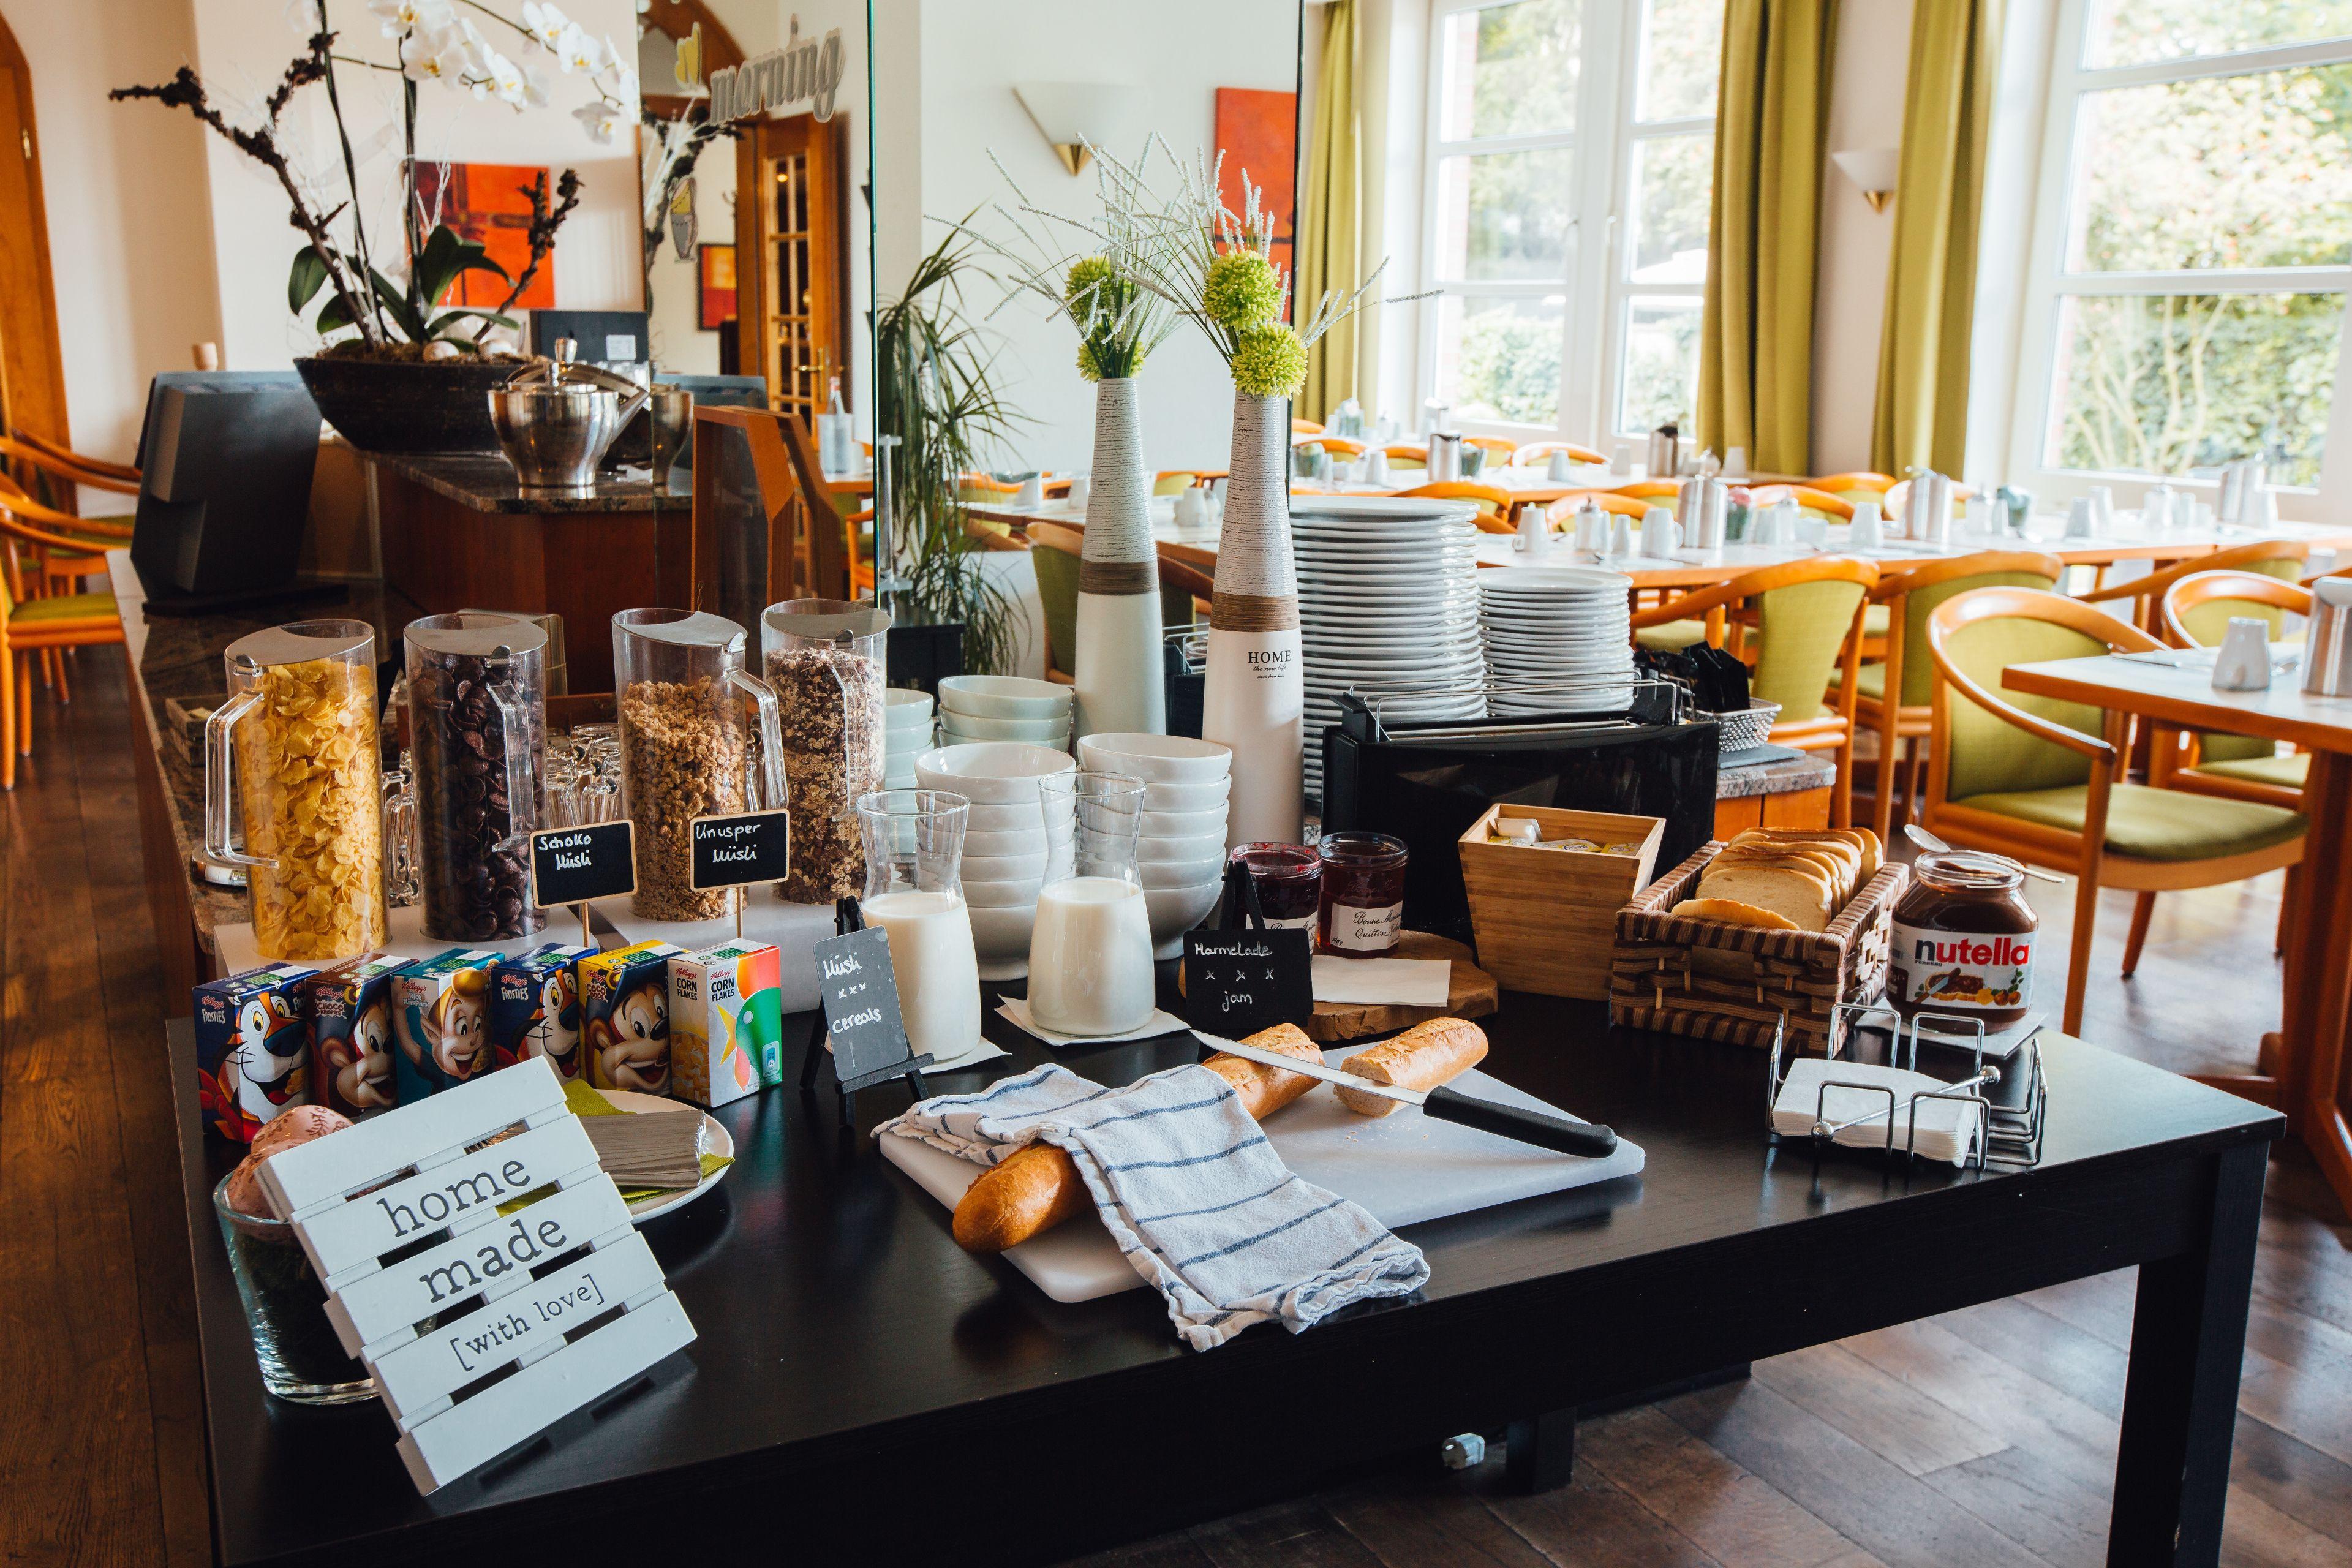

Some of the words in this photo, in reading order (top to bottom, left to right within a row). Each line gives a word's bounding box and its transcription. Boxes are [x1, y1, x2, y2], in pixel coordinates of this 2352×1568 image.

[709, 13, 846, 123] morning
[1248, 650, 1292, 663] HOME
[1277, 663, 1287, 673] life
[1353, 911, 1381, 925] Bonne
[1915, 937, 2030, 966] nutella
[501, 974, 528, 987] Kellogg's
[586, 969, 606, 984] Kellogg's
[676, 967, 697, 981] Kellogg's
[710, 968, 734, 980] Kellogg's
[401, 981, 427, 993] Kellogg's
[586, 983, 606, 995] COCO
[676, 978, 697, 992] CORN
[711, 977, 734, 993] CORN
[316, 986, 344, 1000] Kellogg's
[501, 987, 529, 1001] FROSTIES
[677, 989, 698, 1001] FLAKES
[712, 989, 734, 1002] FLAKES
[202, 995, 225, 1009] Kellogg's
[317, 1002, 344, 1011] CHOCO
[1221, 990, 1253, 1012] jam
[202, 1008, 226, 1025] FROSTIES
[832, 1008, 881, 1034] cereals
[377, 1160, 531, 1238] home
[419, 1219, 567, 1304] made
[450, 1314, 530, 1371] [with
[533, 1273, 605, 1322] love]
